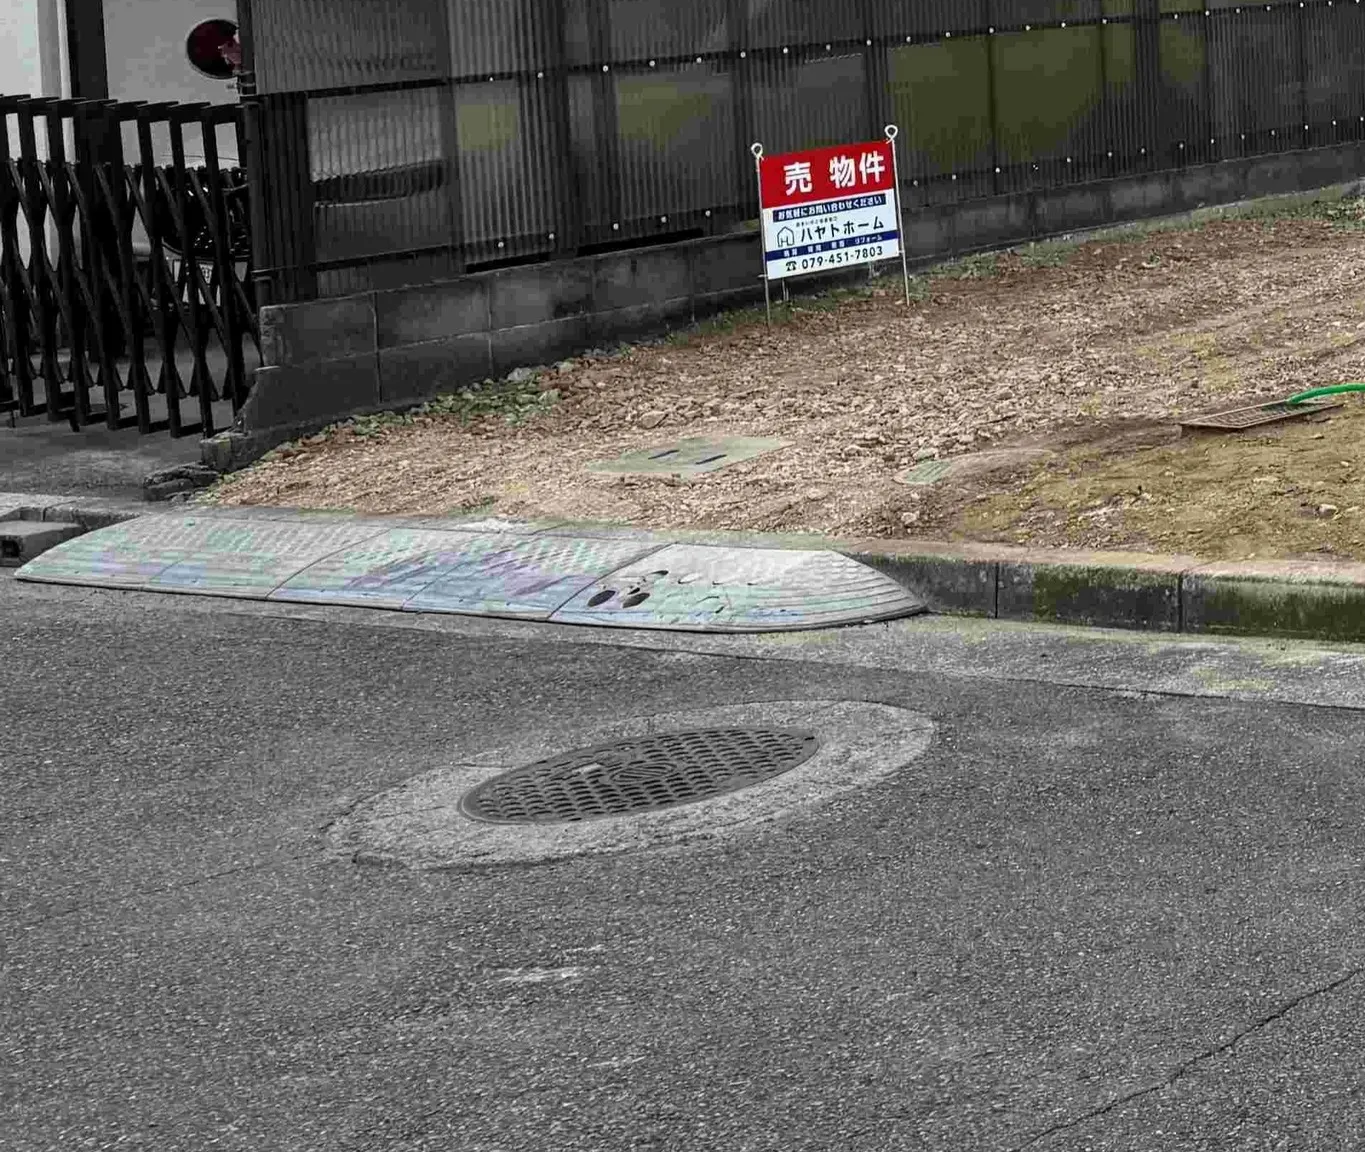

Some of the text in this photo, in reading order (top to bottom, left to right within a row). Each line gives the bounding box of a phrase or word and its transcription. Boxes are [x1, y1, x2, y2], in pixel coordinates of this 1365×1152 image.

[801, 216, 884, 243] ハヤトホーム
